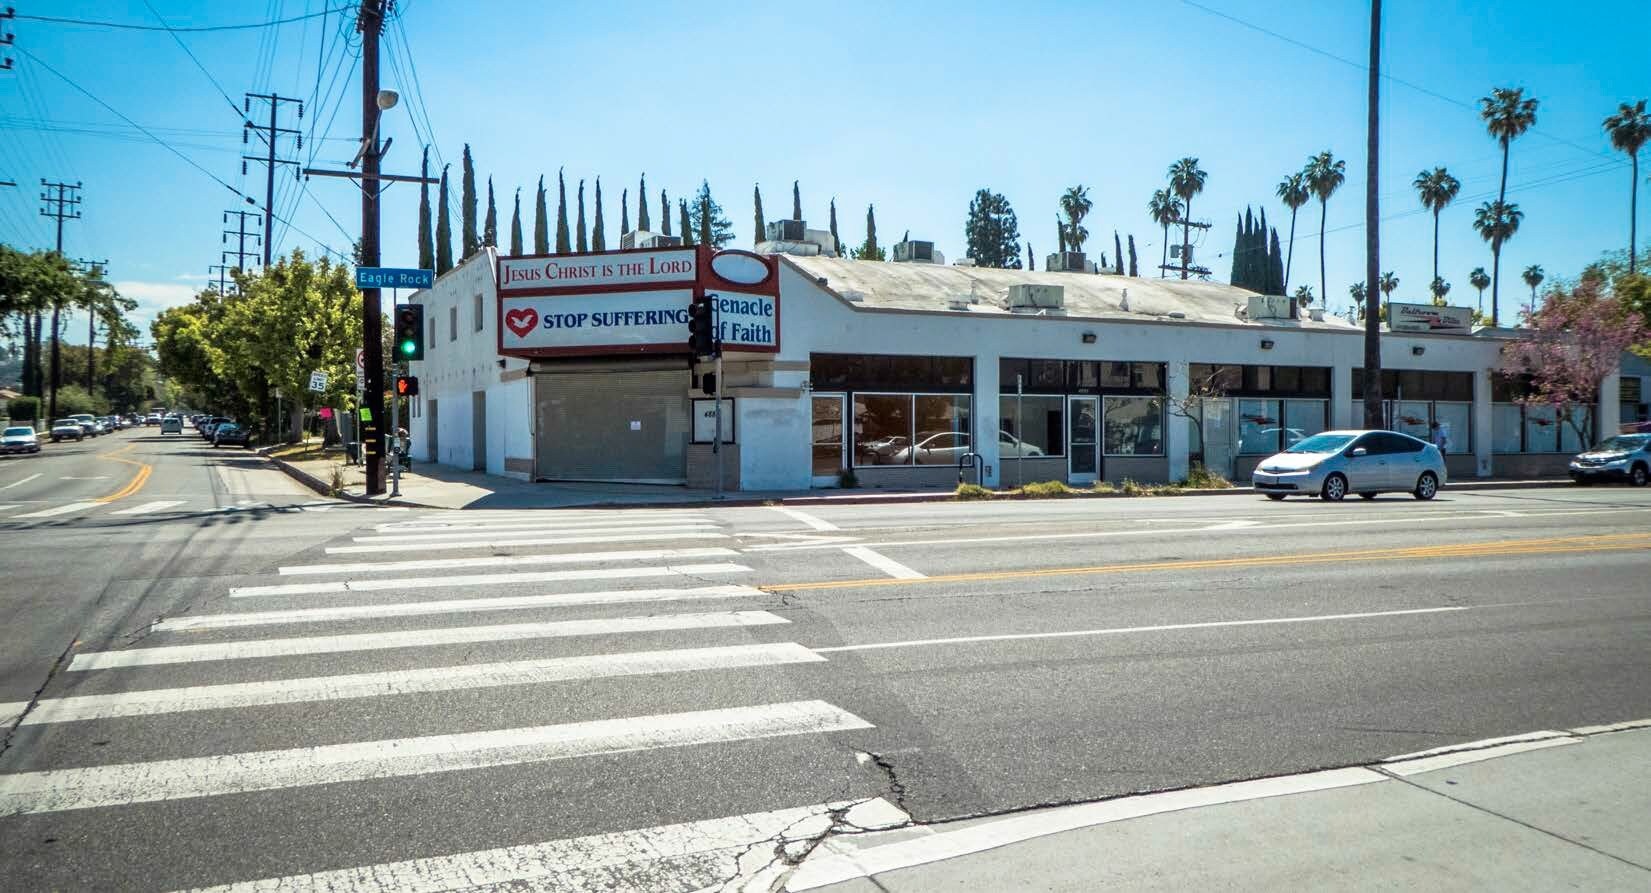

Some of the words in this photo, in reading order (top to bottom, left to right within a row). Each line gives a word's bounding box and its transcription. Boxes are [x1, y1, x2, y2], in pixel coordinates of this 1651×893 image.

[360, 272, 394, 286] Eagle
[400, 273, 429, 285] Rock
[503, 264, 541, 285] JESUS
[545, 262, 597, 280] CHRIST
[602, 264, 613, 277] IS
[617, 263, 645, 276] THE
[648, 256, 692, 274] LORD
[543, 313, 588, 329] STOP
[591, 309, 689, 327] SUFFERING
[732, 322, 772, 343] Faith
[311, 381, 325, 390] 35
